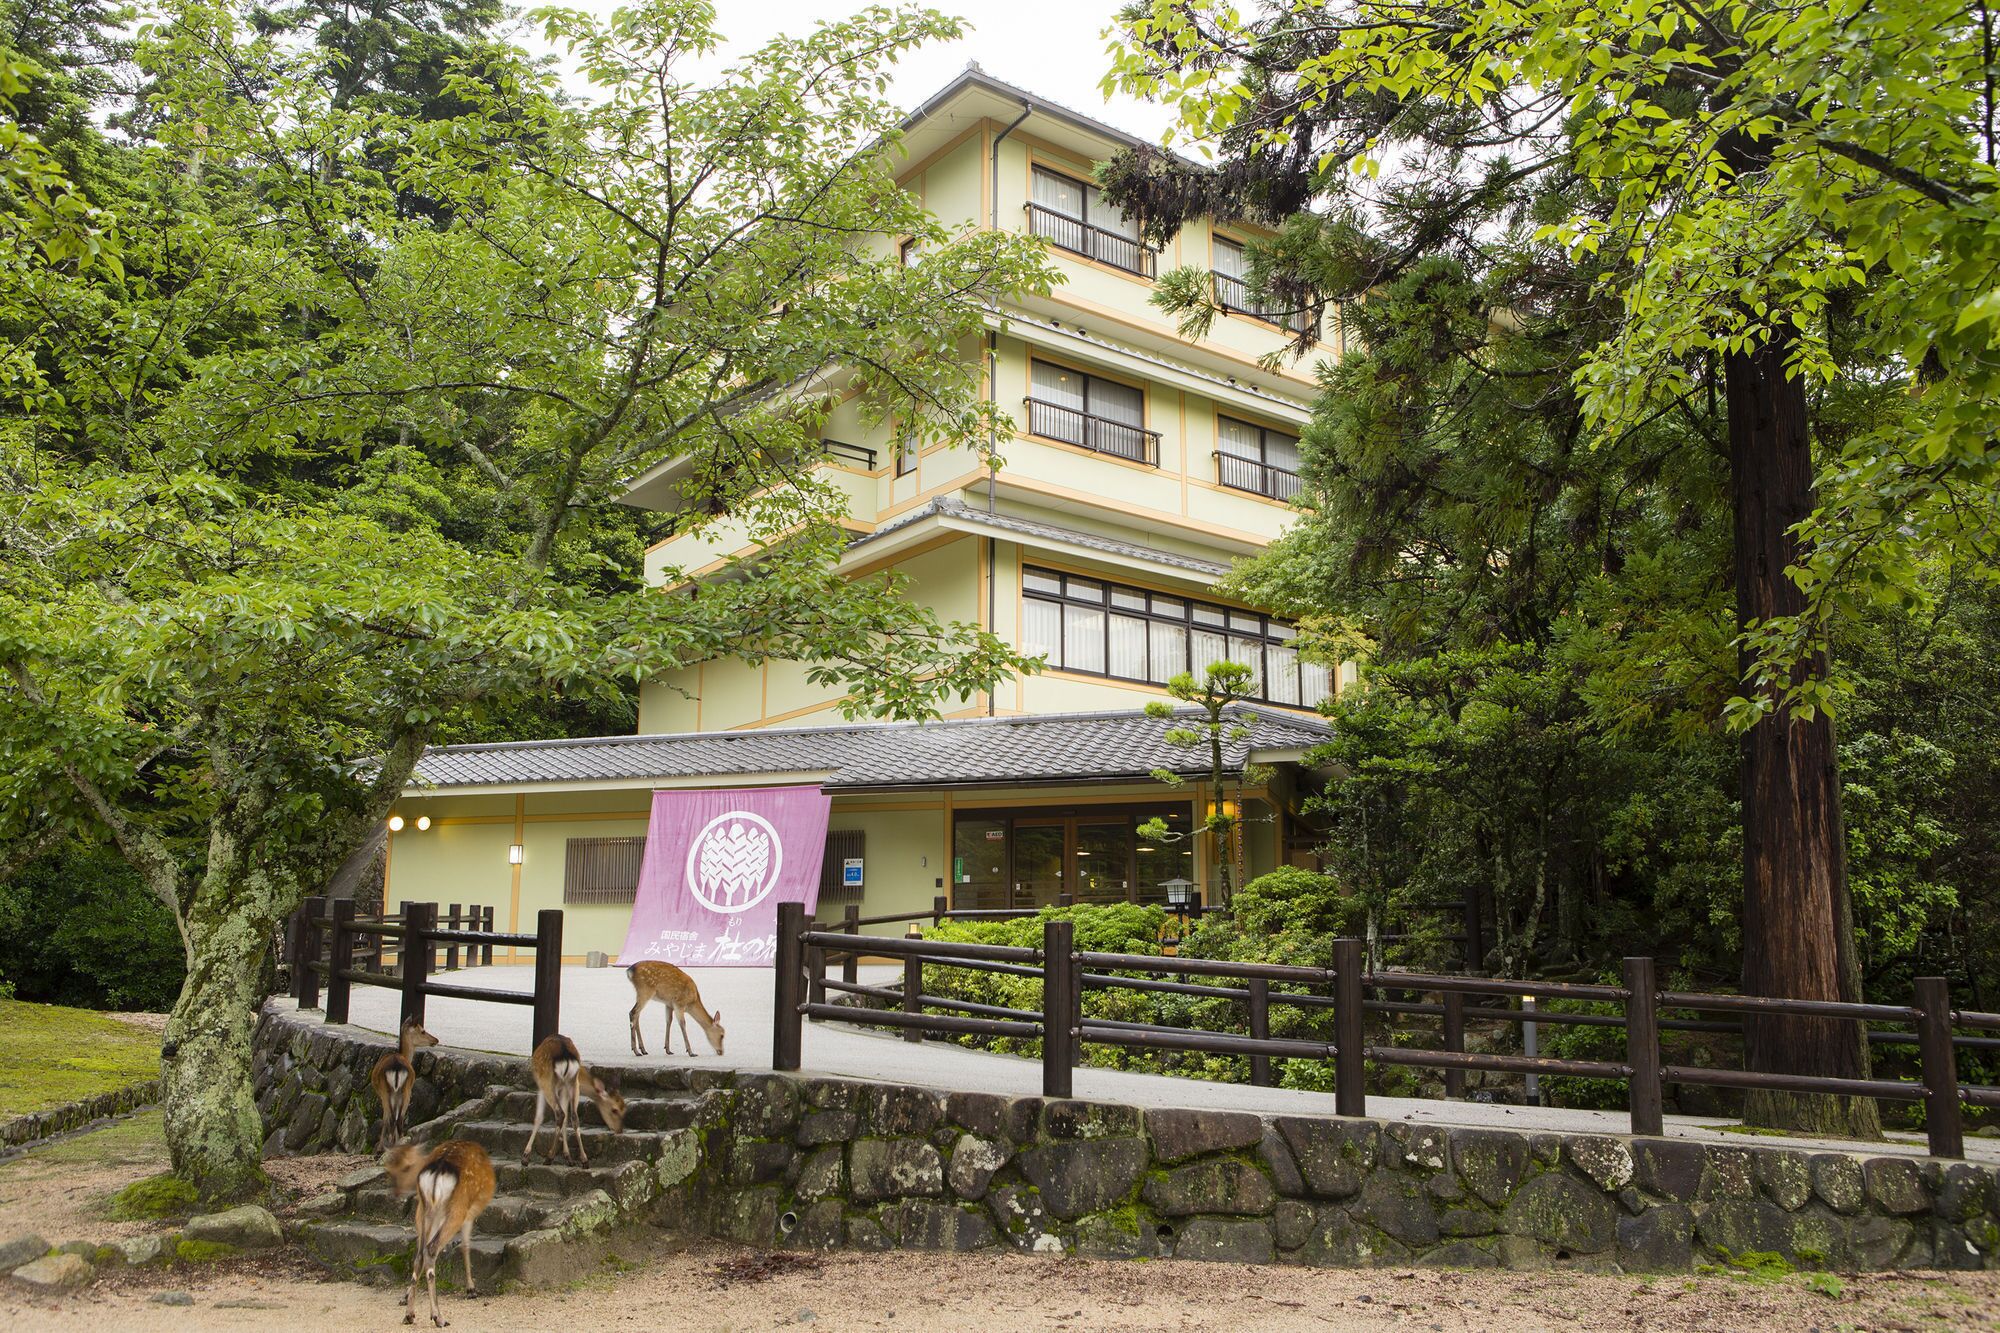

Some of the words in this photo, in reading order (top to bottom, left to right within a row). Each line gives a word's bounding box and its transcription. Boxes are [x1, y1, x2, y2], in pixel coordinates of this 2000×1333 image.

[728, 917, 743, 927] もり
[644, 941, 708, 960] みやじま
